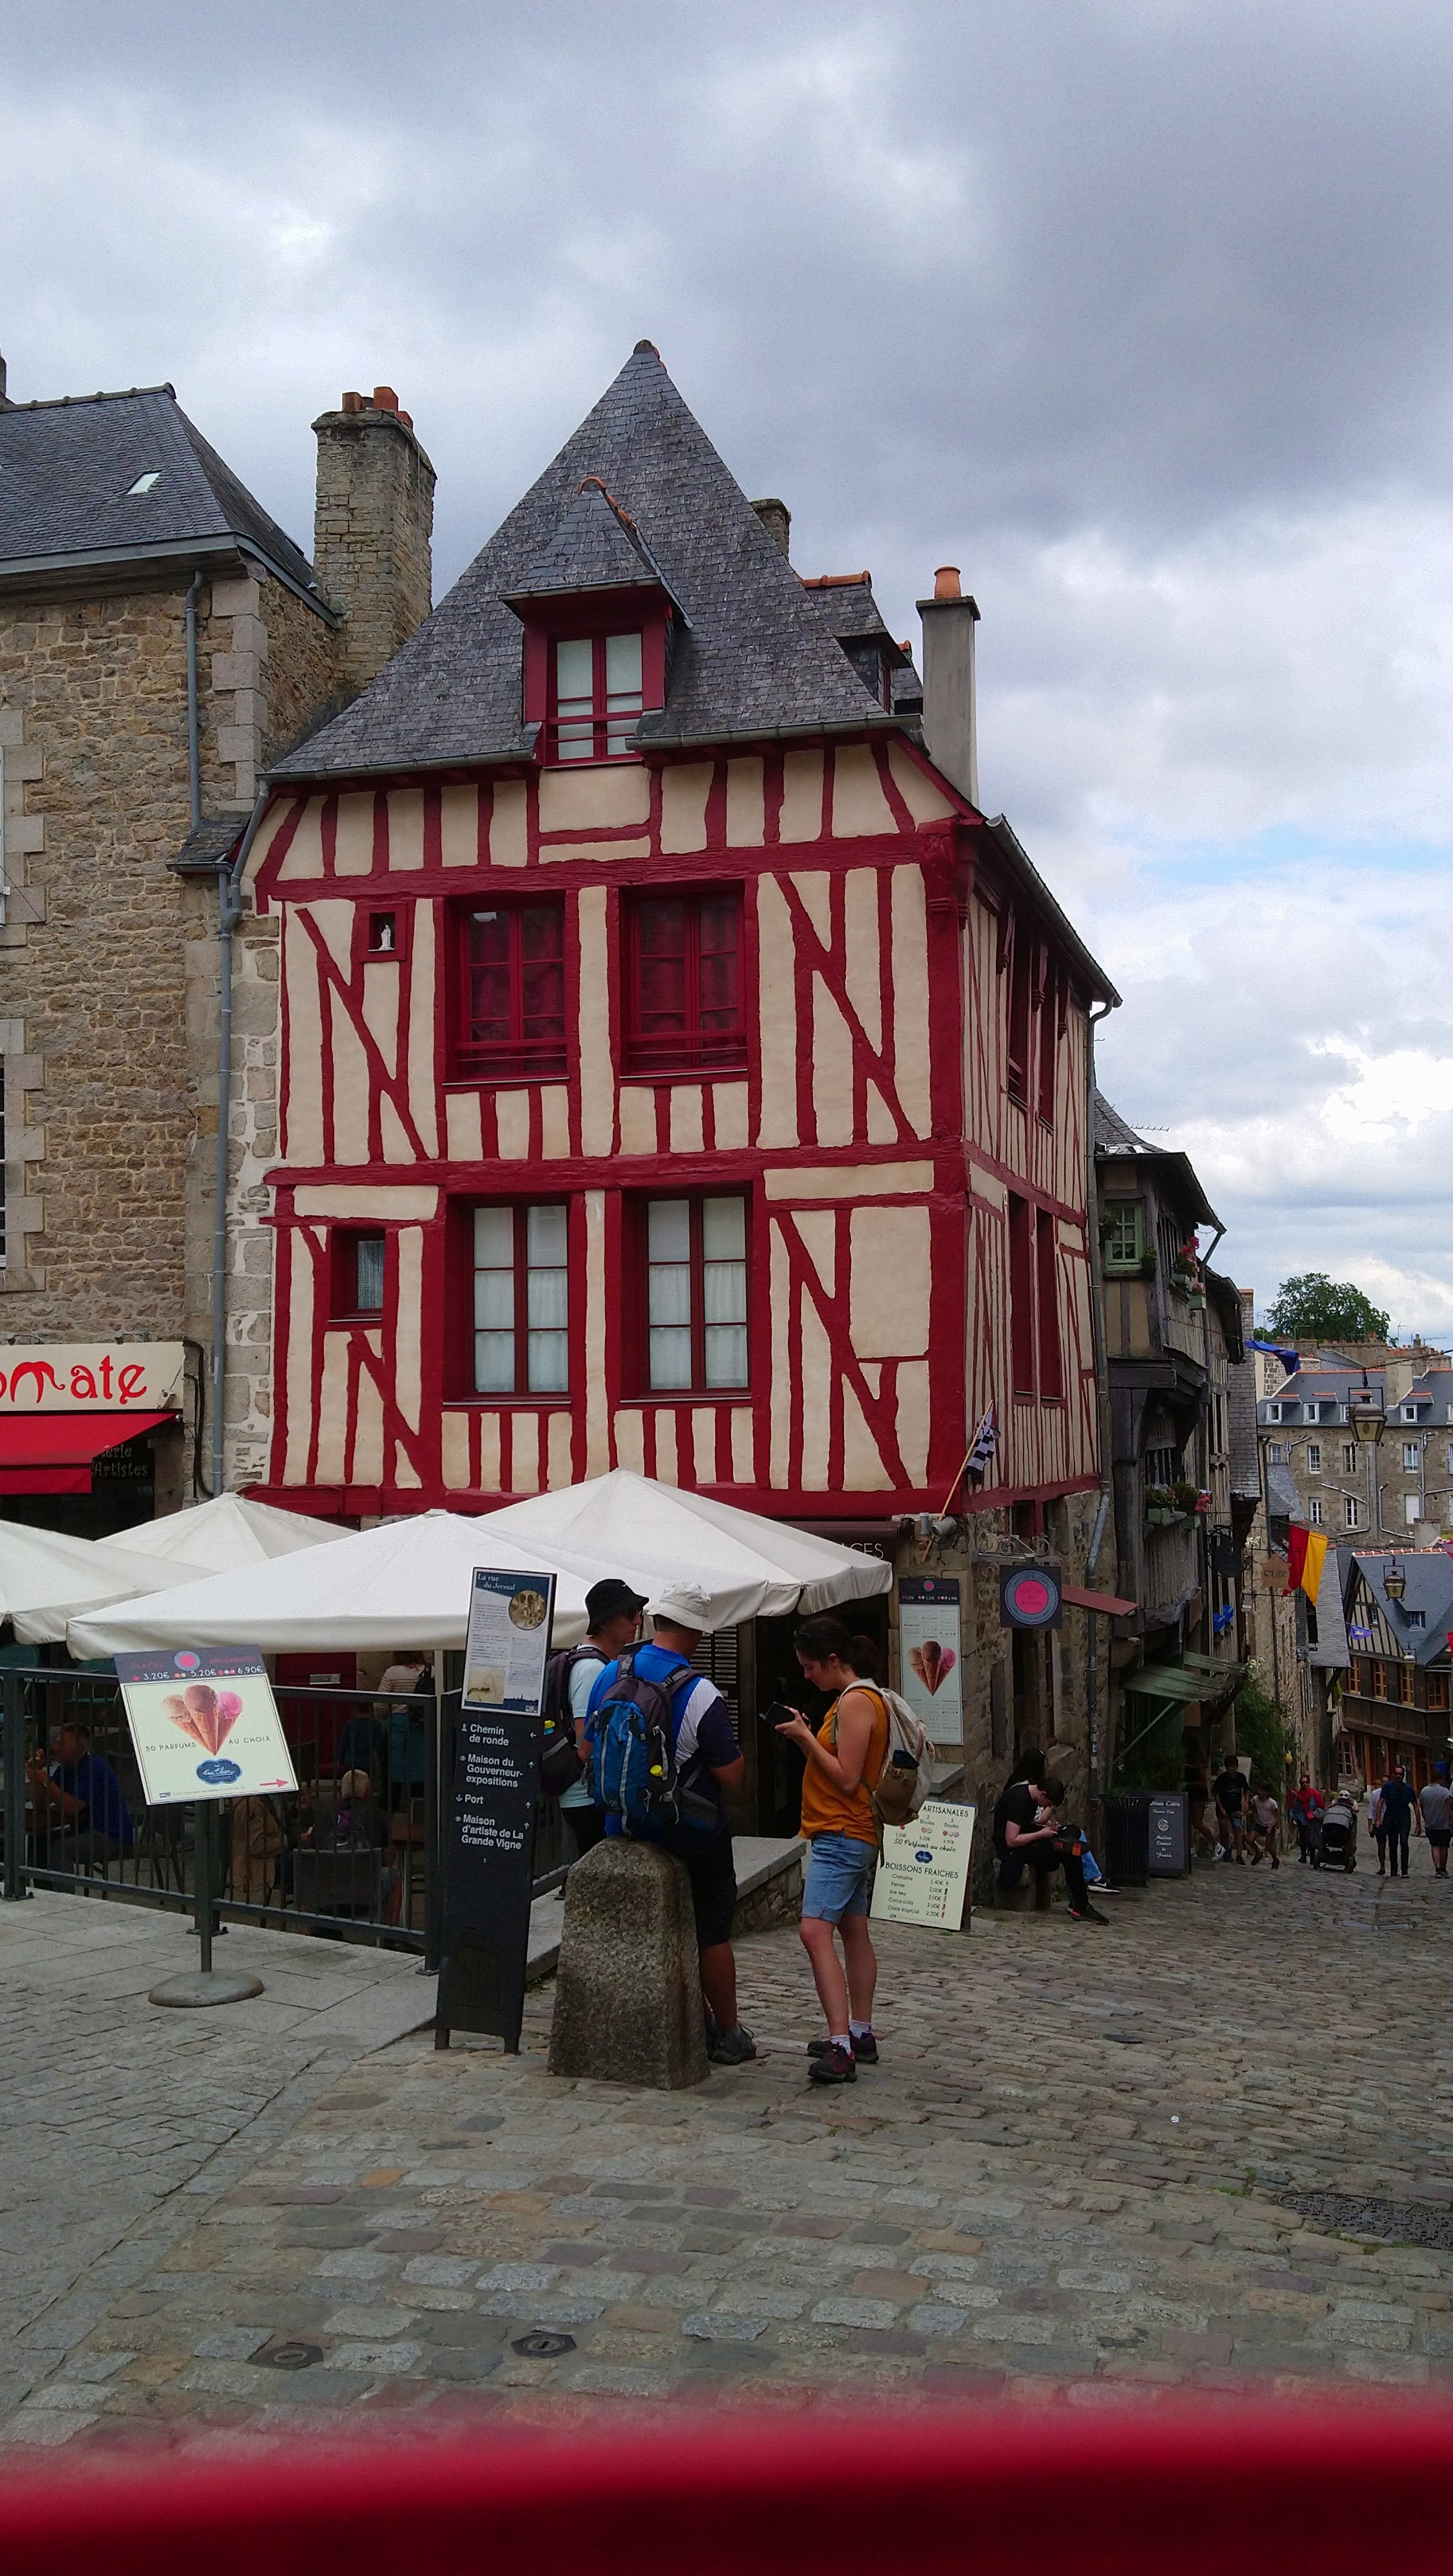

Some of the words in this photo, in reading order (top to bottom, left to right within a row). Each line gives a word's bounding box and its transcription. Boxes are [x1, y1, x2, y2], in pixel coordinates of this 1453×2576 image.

[0, 1355, 147, 1404] mate
[143, 1672, 169, 1681] 3.20€
[191, 1668, 217, 1677] 5.20€
[237, 1666, 262, 1674] 6.90€
[470, 1724, 504, 1735] Chemin
[159, 1742, 196, 1750] PARFUMS
[469, 1734, 480, 1742] de
[483, 1737, 509, 1746] ronde
[468, 1754, 500, 1765] Maison
[502, 1757, 514, 1767] du
[467, 1764, 523, 1777] Gouverneur-
[466, 1775, 518, 1787] expositions
[464, 1794, 484, 1804] Port
[922, 1805, 968, 1817] ARTISANALES
[463, 1814, 495, 1826] Maison
[462, 1825, 498, 1837] d'artiste
[499, 1829, 511, 1838] de
[513, 1830, 524, 1839] La
[461, 1834, 494, 1846] Grande
[496, 1838, 521, 1850] Vigne
[885, 1862, 922, 1874] BOISSONS
[925, 1868, 959, 1879] FRAICHES
